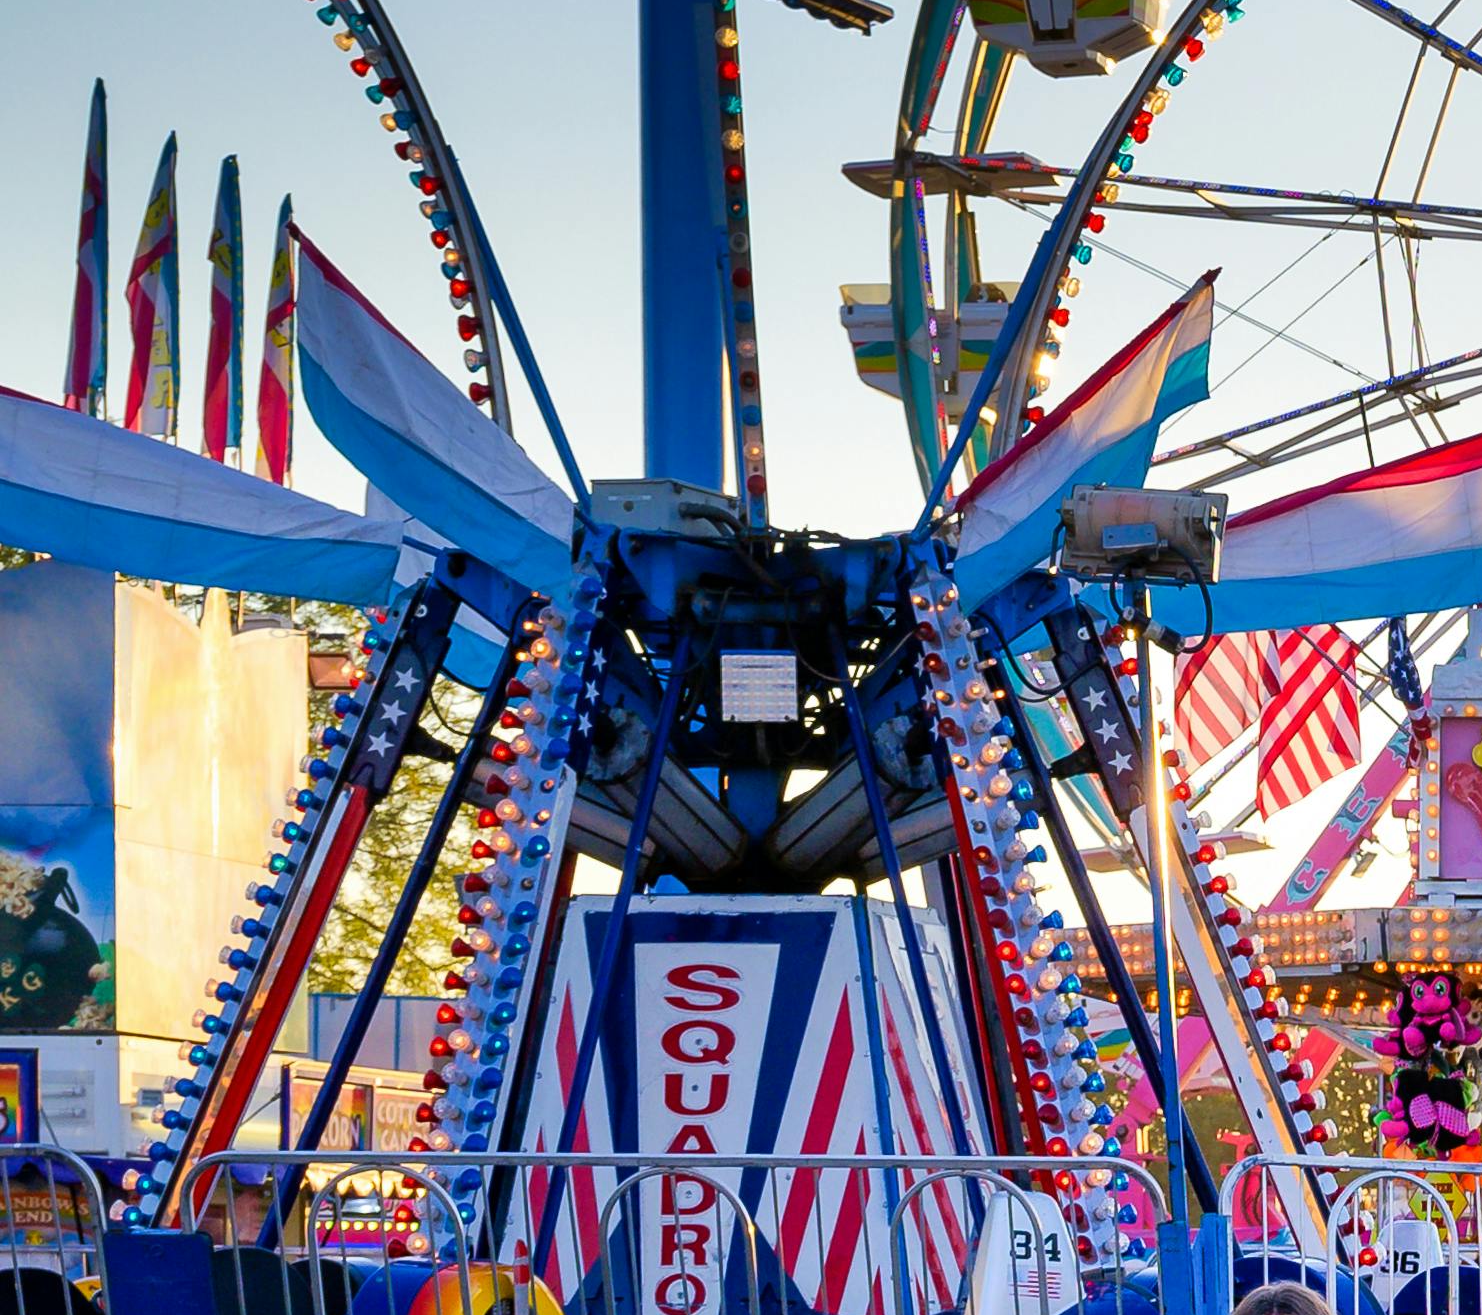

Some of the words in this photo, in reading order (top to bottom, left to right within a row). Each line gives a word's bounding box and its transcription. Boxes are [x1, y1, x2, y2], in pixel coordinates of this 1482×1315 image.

[15, 1210, 53, 1223] END
[1012, 1229, 1061, 1262] 34
[1380, 1251, 1421, 1275] 36
